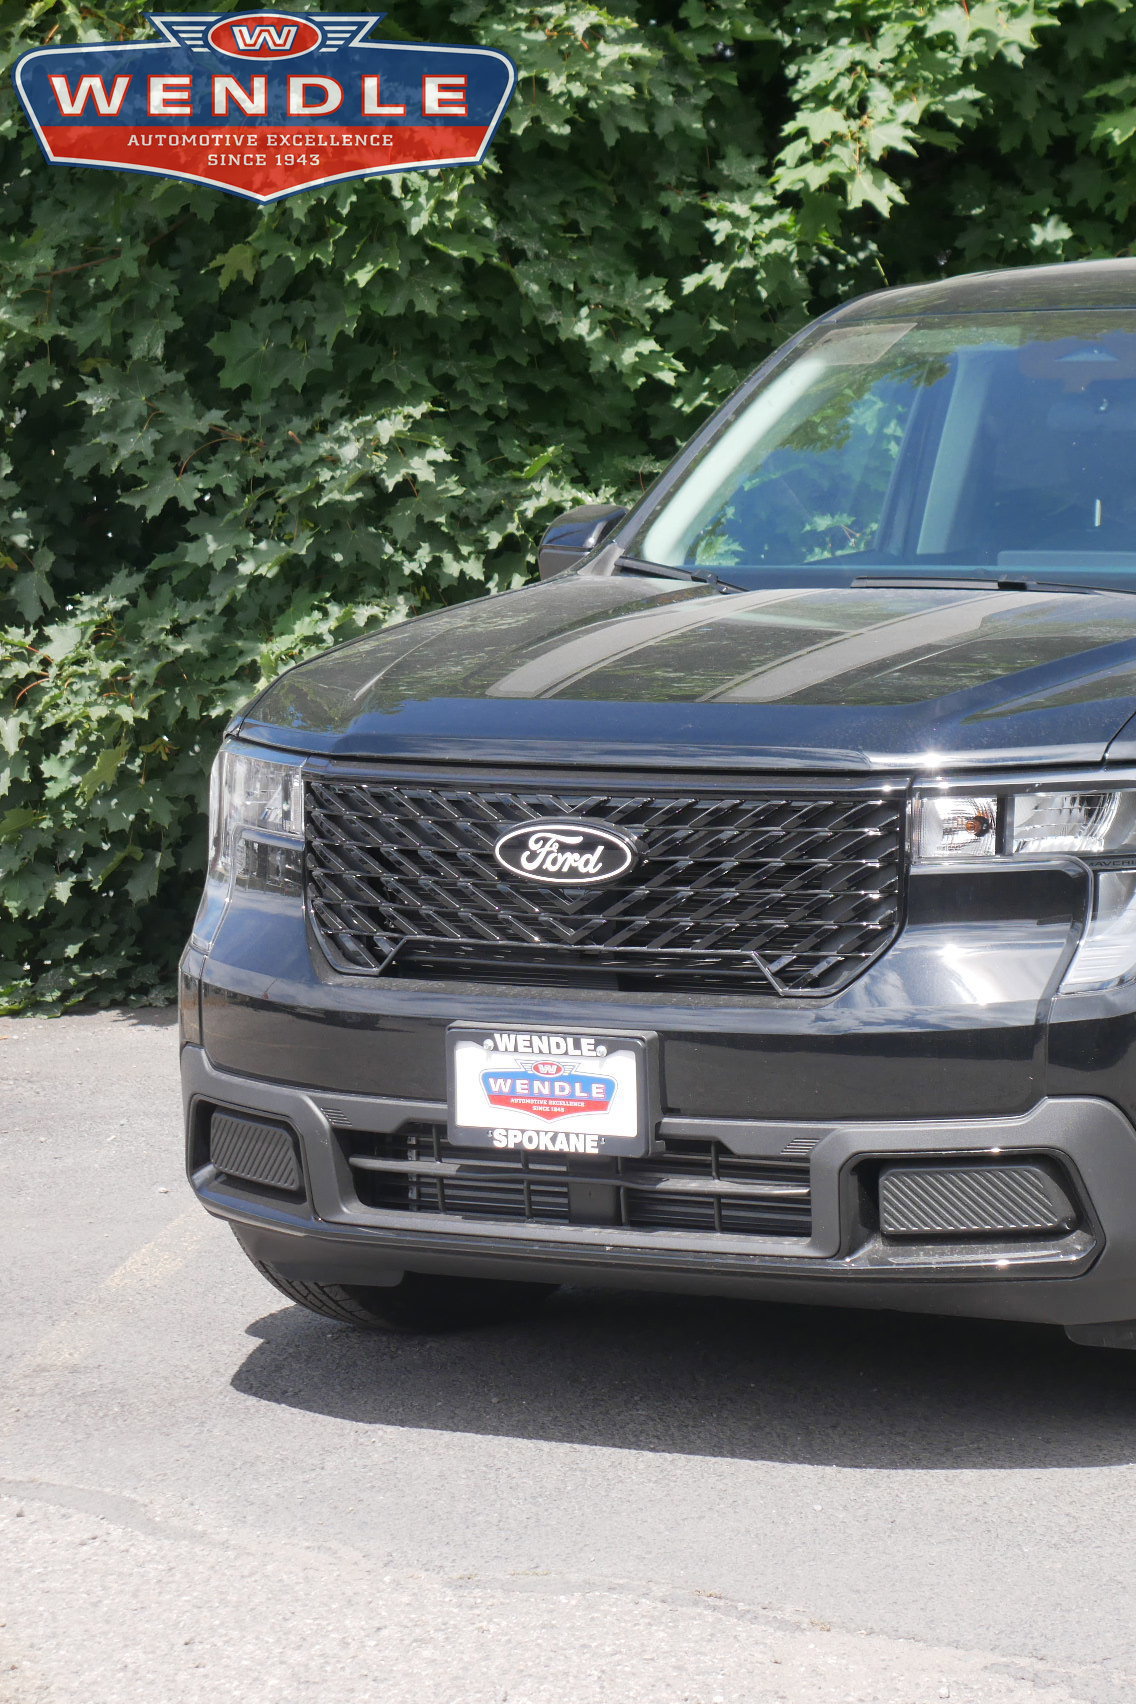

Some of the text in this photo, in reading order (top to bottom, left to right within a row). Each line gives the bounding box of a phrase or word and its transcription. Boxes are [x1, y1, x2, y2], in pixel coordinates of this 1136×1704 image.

[520, 832, 605, 874] Ford
[494, 1033, 597, 1056] WENDLE
[489, 1078, 606, 1098] WENDLE
[493, 1129, 599, 1154] SPOKANE
